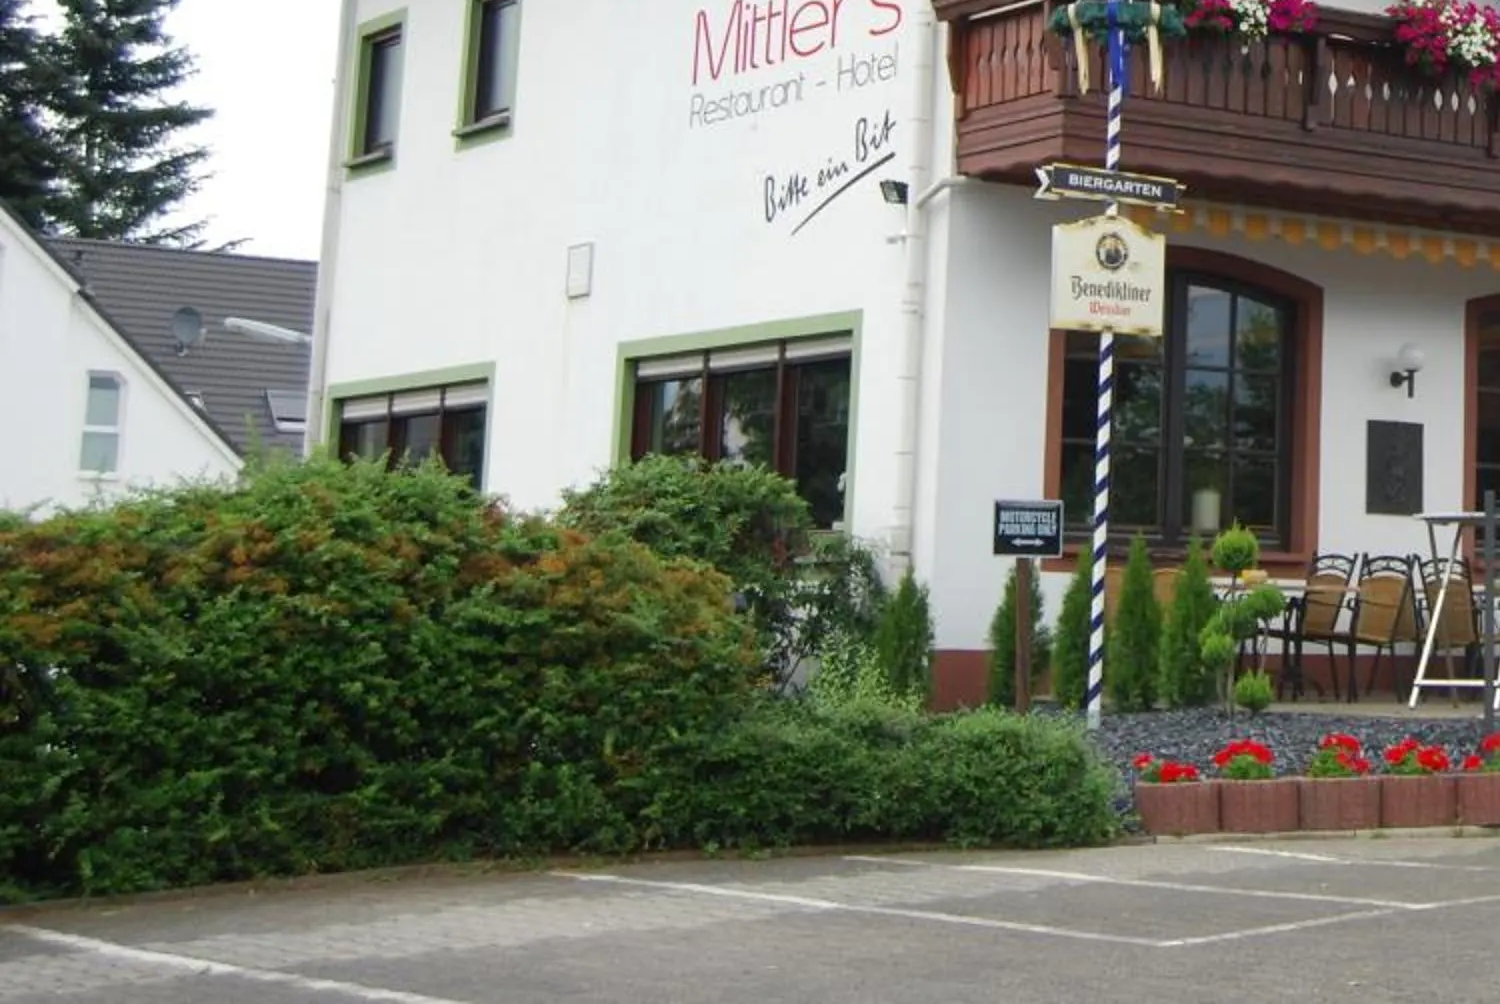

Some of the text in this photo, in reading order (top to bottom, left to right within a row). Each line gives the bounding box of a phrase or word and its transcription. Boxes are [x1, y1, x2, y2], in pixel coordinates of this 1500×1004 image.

[689, 71, 805, 129] Restaurant
[837, 42, 898, 92] Hotel
[764, 108, 897, 223] Bitte ein Bit
[1068, 173, 1162, 197] BIERGARTEN
[1071, 275, 1153, 302] Benediktiner
[998, 523, 1036, 536] PARKING
[1000, 510, 1057, 524] MOTORCYCLE
